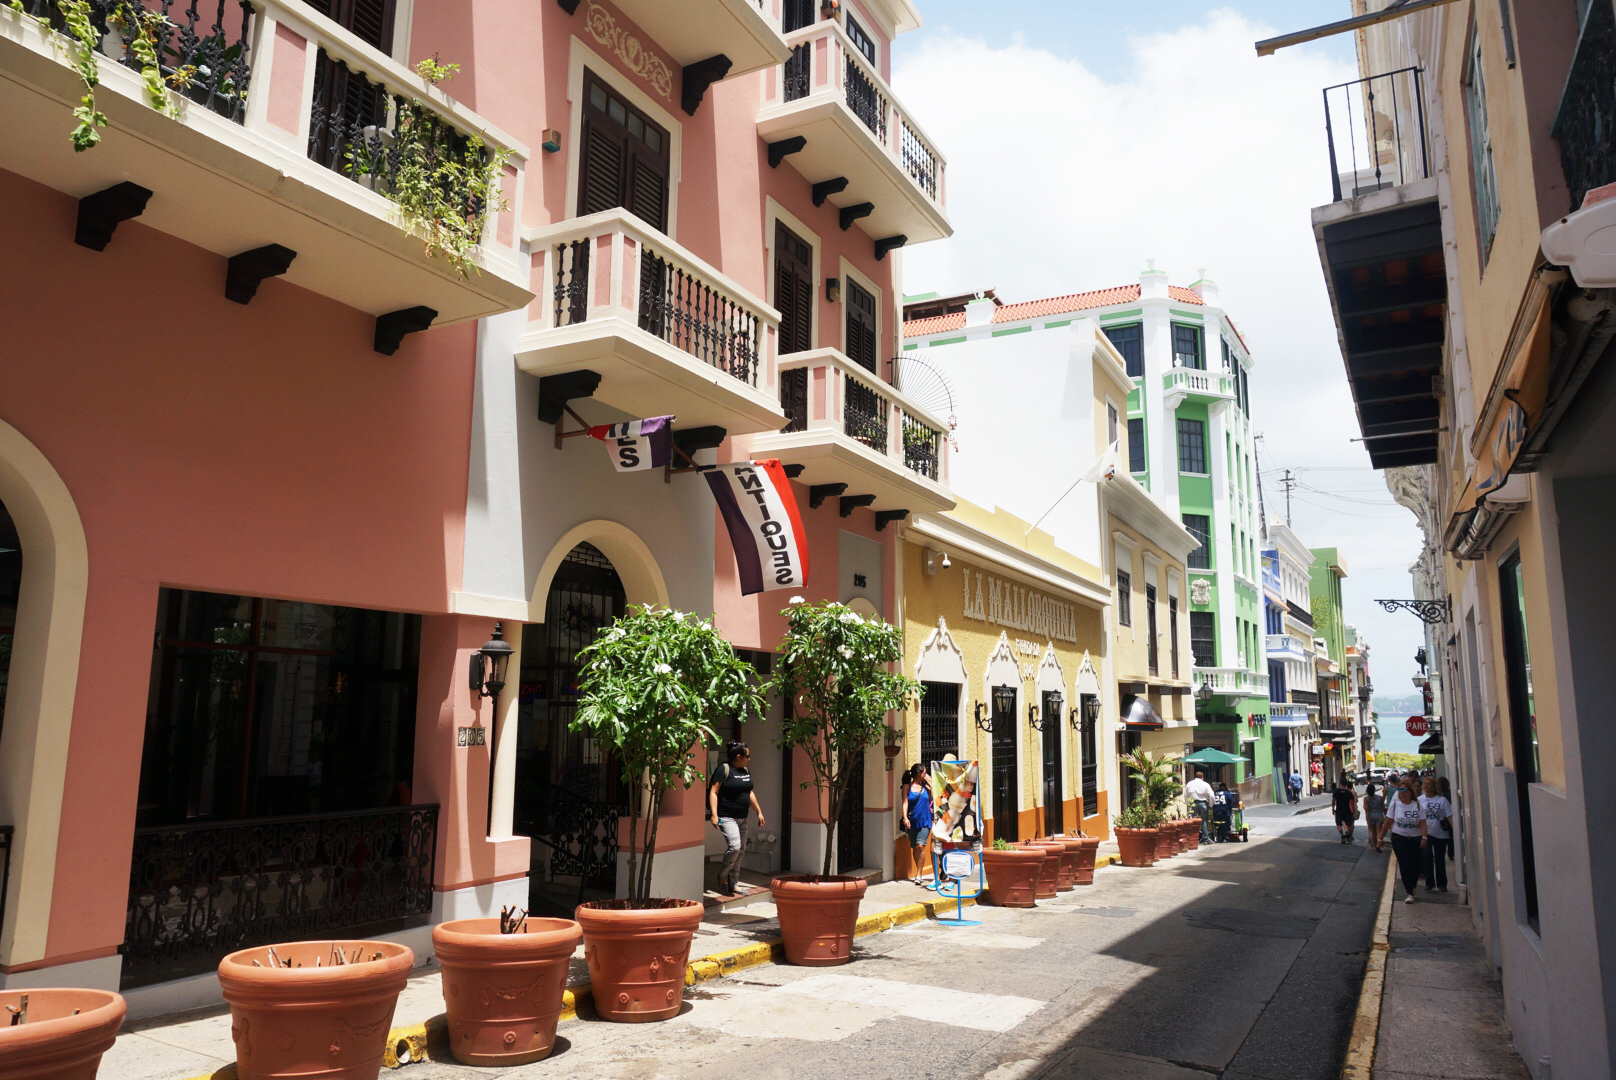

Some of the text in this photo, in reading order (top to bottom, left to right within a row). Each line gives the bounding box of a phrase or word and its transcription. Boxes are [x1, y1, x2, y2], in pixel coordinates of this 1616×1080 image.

[963, 567, 1077, 643] LA MALLORQUINA
[1406, 721, 1428, 731] PARE
[459, 730, 485, 744] 205
